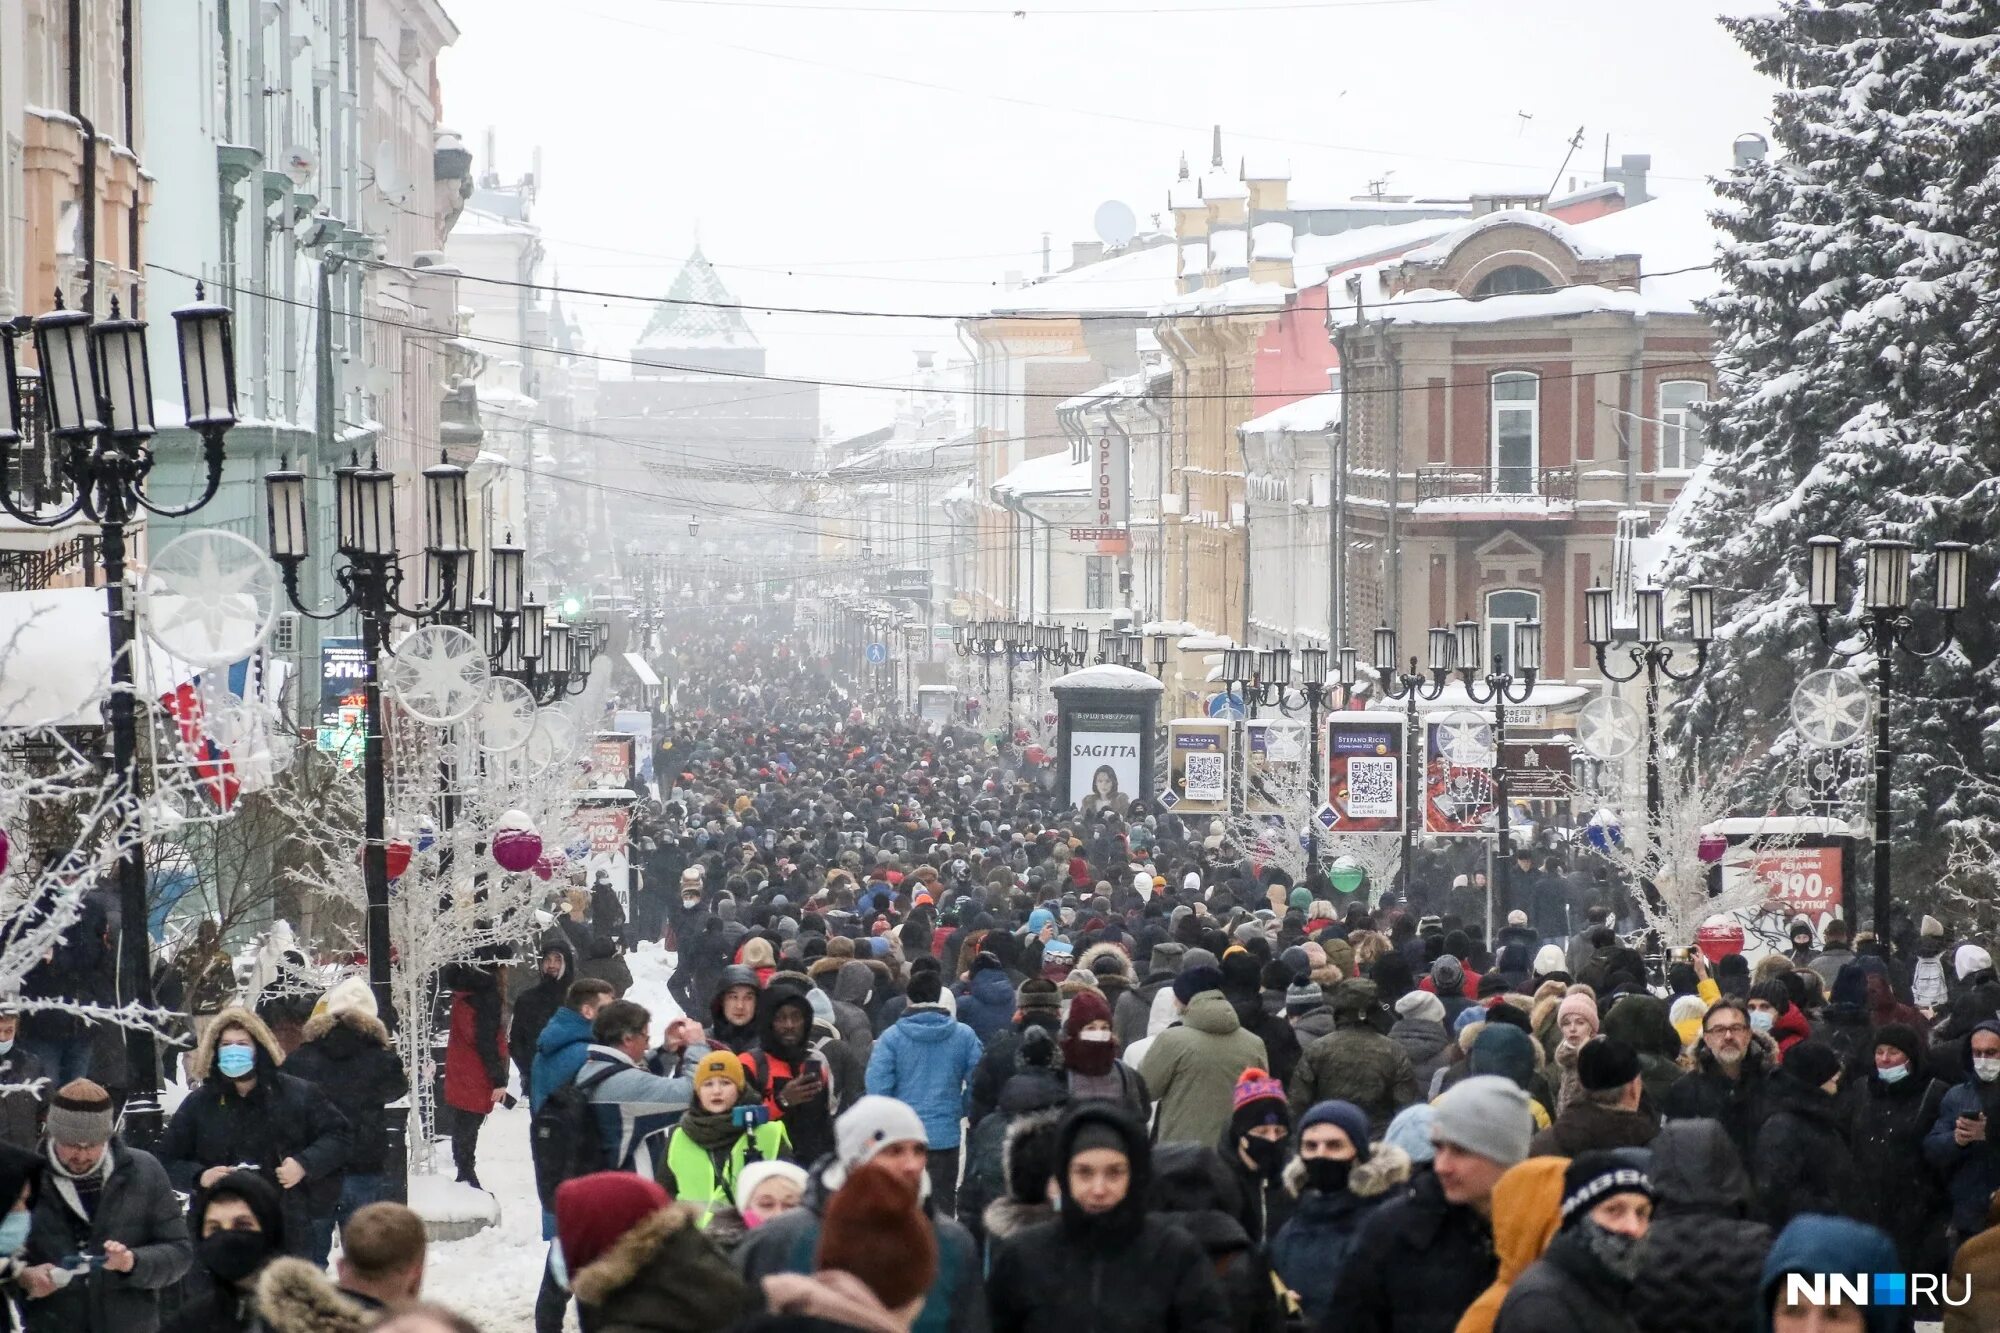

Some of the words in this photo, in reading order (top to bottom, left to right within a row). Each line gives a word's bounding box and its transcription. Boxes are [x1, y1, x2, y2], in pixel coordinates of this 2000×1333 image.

[1098, 426, 1111, 525] ТОРГОВЫЙ
[1073, 744, 1136, 758] SAGITTA
[1779, 872, 1823, 898] 190
